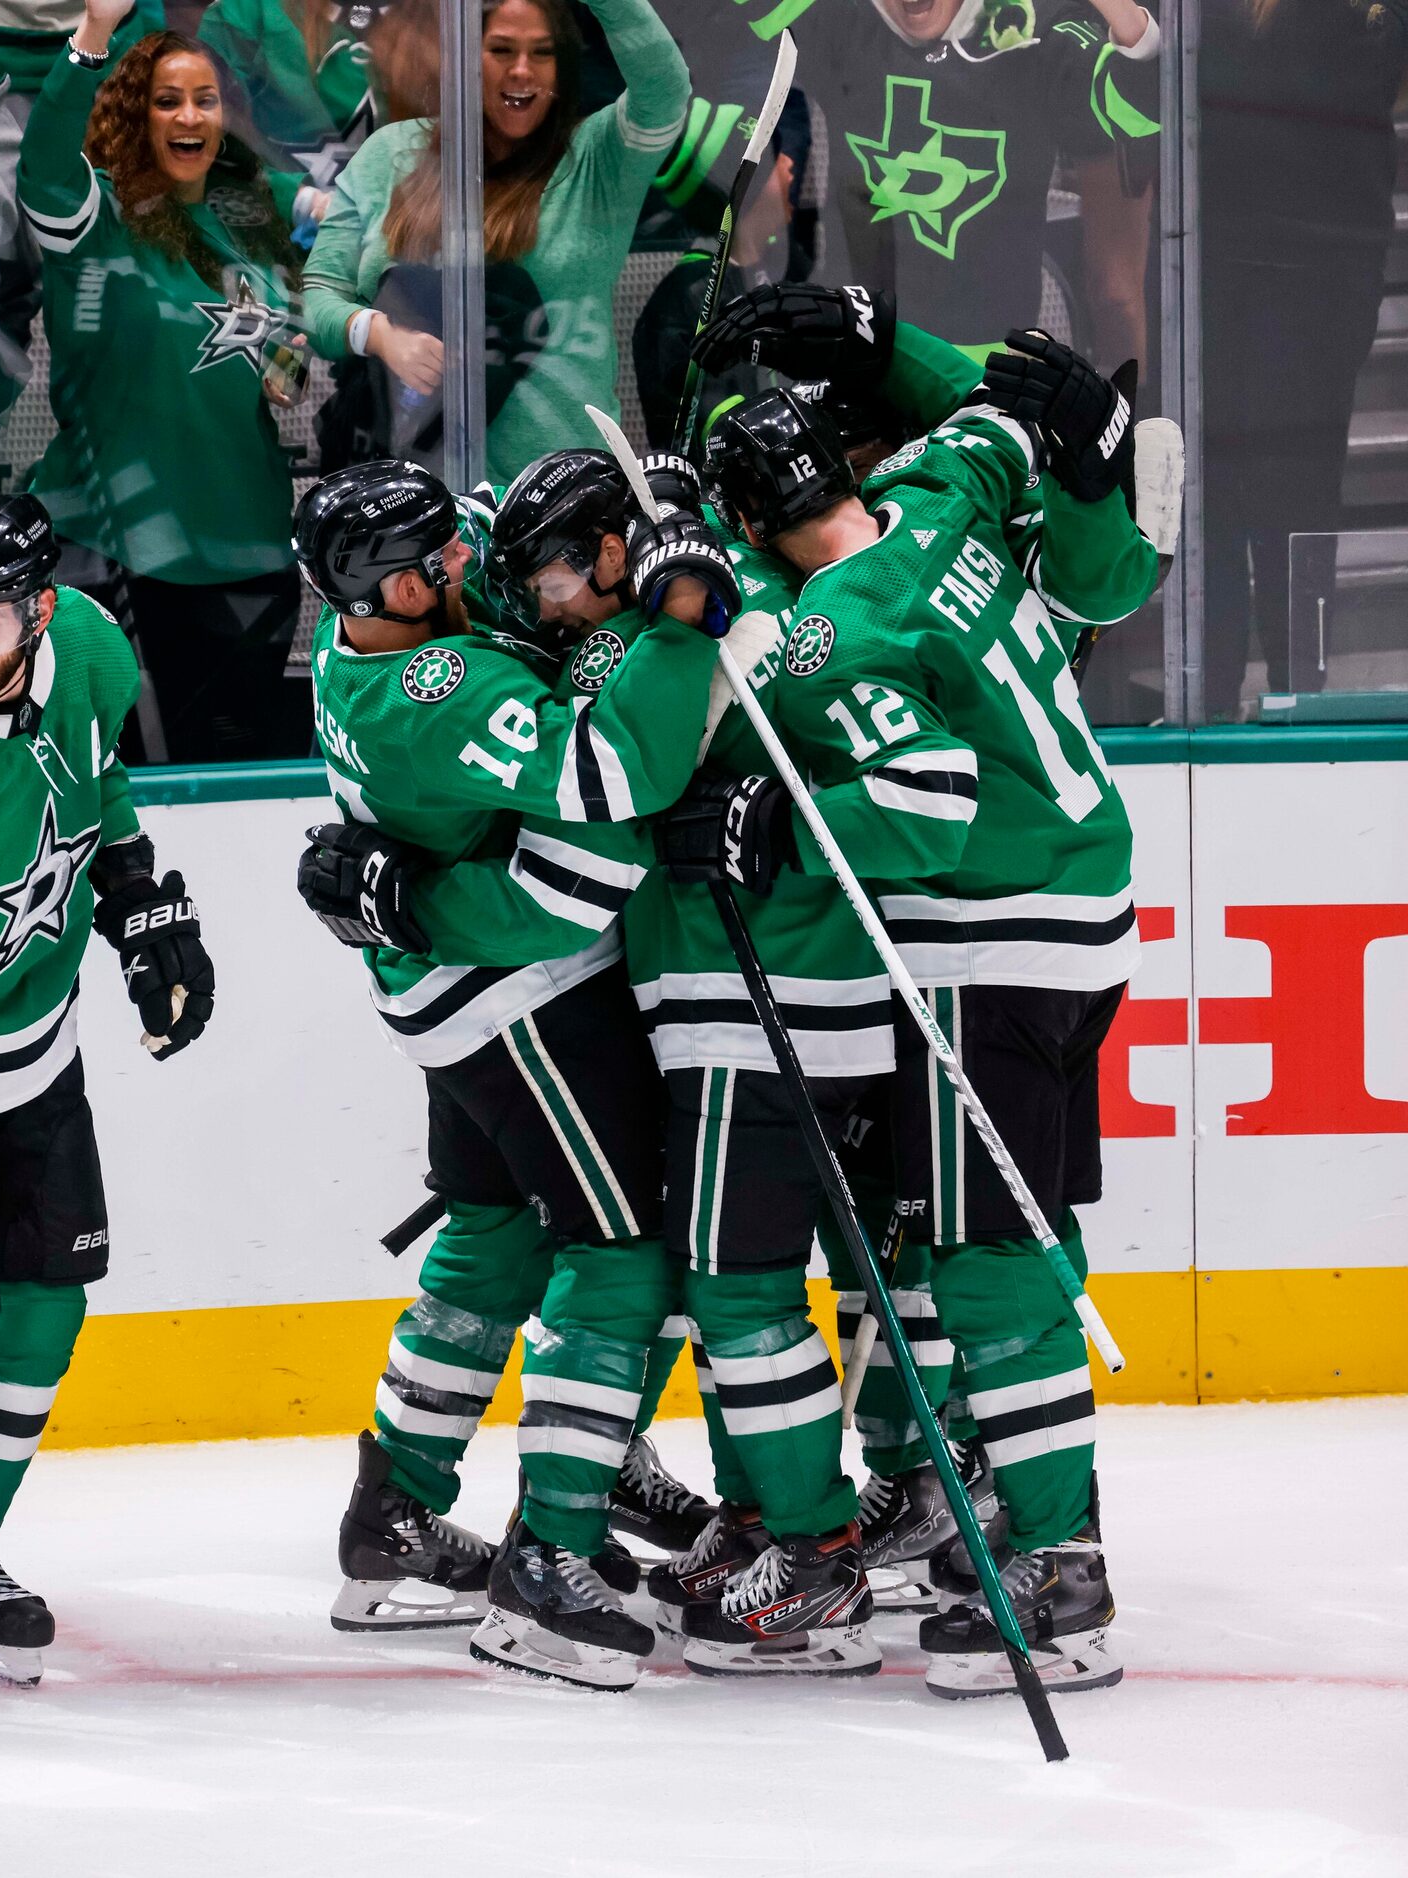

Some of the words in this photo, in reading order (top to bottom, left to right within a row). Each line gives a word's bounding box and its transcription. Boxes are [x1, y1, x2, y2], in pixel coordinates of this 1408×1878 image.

[843, 285, 875, 345] CM
[542, 462, 567, 487] ENERGY
[545, 464, 578, 491] TRANSFER
[789, 453, 817, 483] 12
[379, 489, 407, 505] ENERGY
[382, 492, 417, 512] TRANSFER
[928, 534, 1007, 634] FAKSA
[405, 650, 451, 687] DALLAS
[420, 665, 460, 699] STARS
[825, 681, 921, 763] 12
[981, 588, 1112, 824] 12
[725, 775, 769, 884] CCM
[927, 1022, 952, 1056] ALPHA
[694, 1569, 729, 1591] CCM
[757, 1599, 803, 1627] CCM
